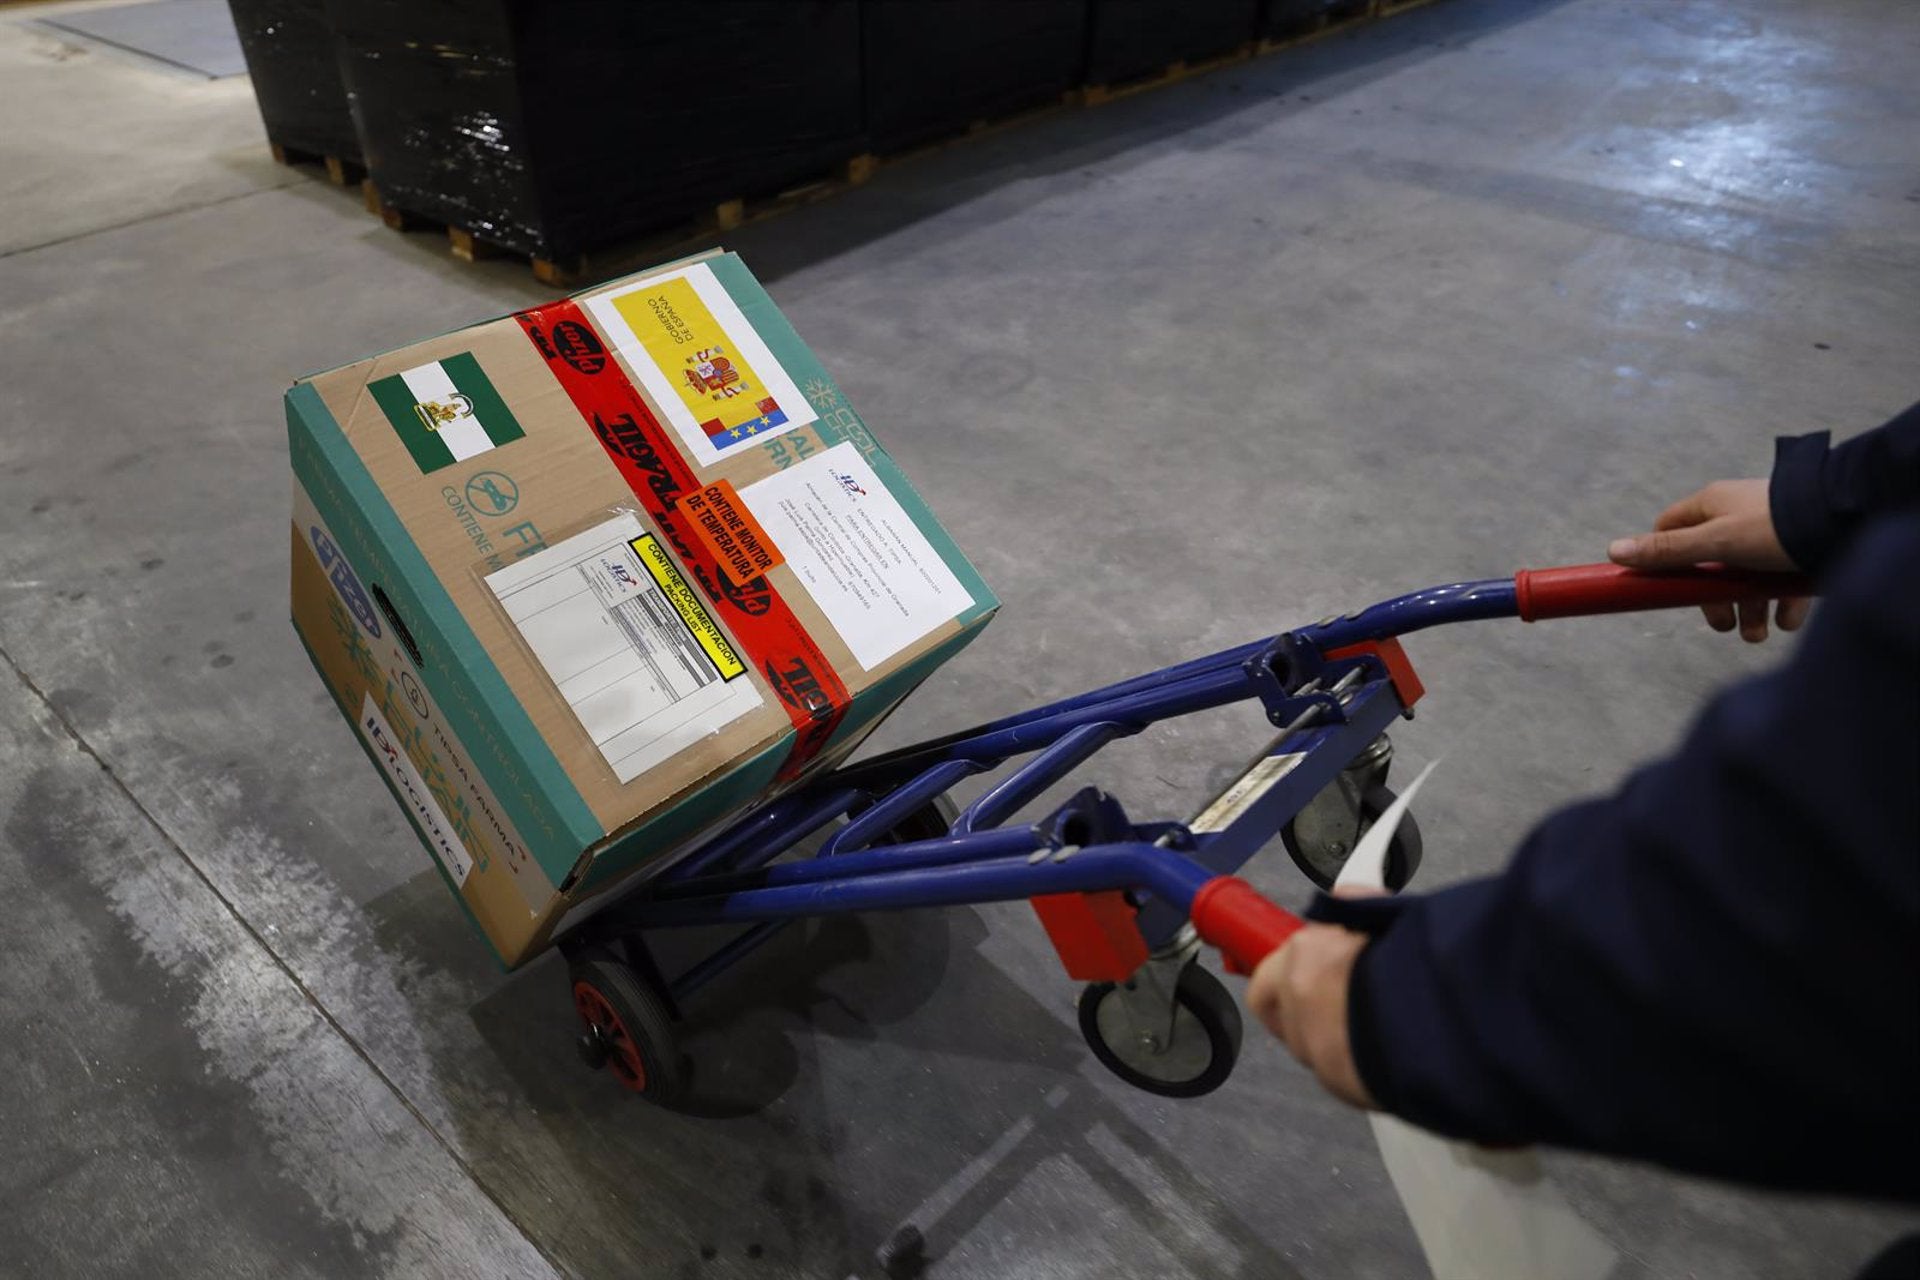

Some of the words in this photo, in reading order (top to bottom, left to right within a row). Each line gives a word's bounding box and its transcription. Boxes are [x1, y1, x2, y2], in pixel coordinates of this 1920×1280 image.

[559, 321, 606, 373] Pfizer
[648, 299, 684, 345] GOBIERNO
[656, 296, 685, 328] ESPAÑA
[680, 329, 693, 341] DE
[442, 486, 494, 555] CONTIENE
[687, 495, 700, 512] DE
[698, 509, 754, 580] TEMPERATURA
[704, 487, 740, 531] CONTIENE
[736, 525, 773, 570] MONITOR
[316, 534, 379, 634] Pfizer
[648, 543, 683, 589] CONTIENE
[679, 587, 737, 666] DOCUMENTACION
[664, 583, 690, 617] PACKING
[687, 615, 702, 632] LIST
[388, 755, 465, 877] LOGISTICS
[432, 721, 468, 782] TIPSA
[470, 782, 516, 856] FARMA
